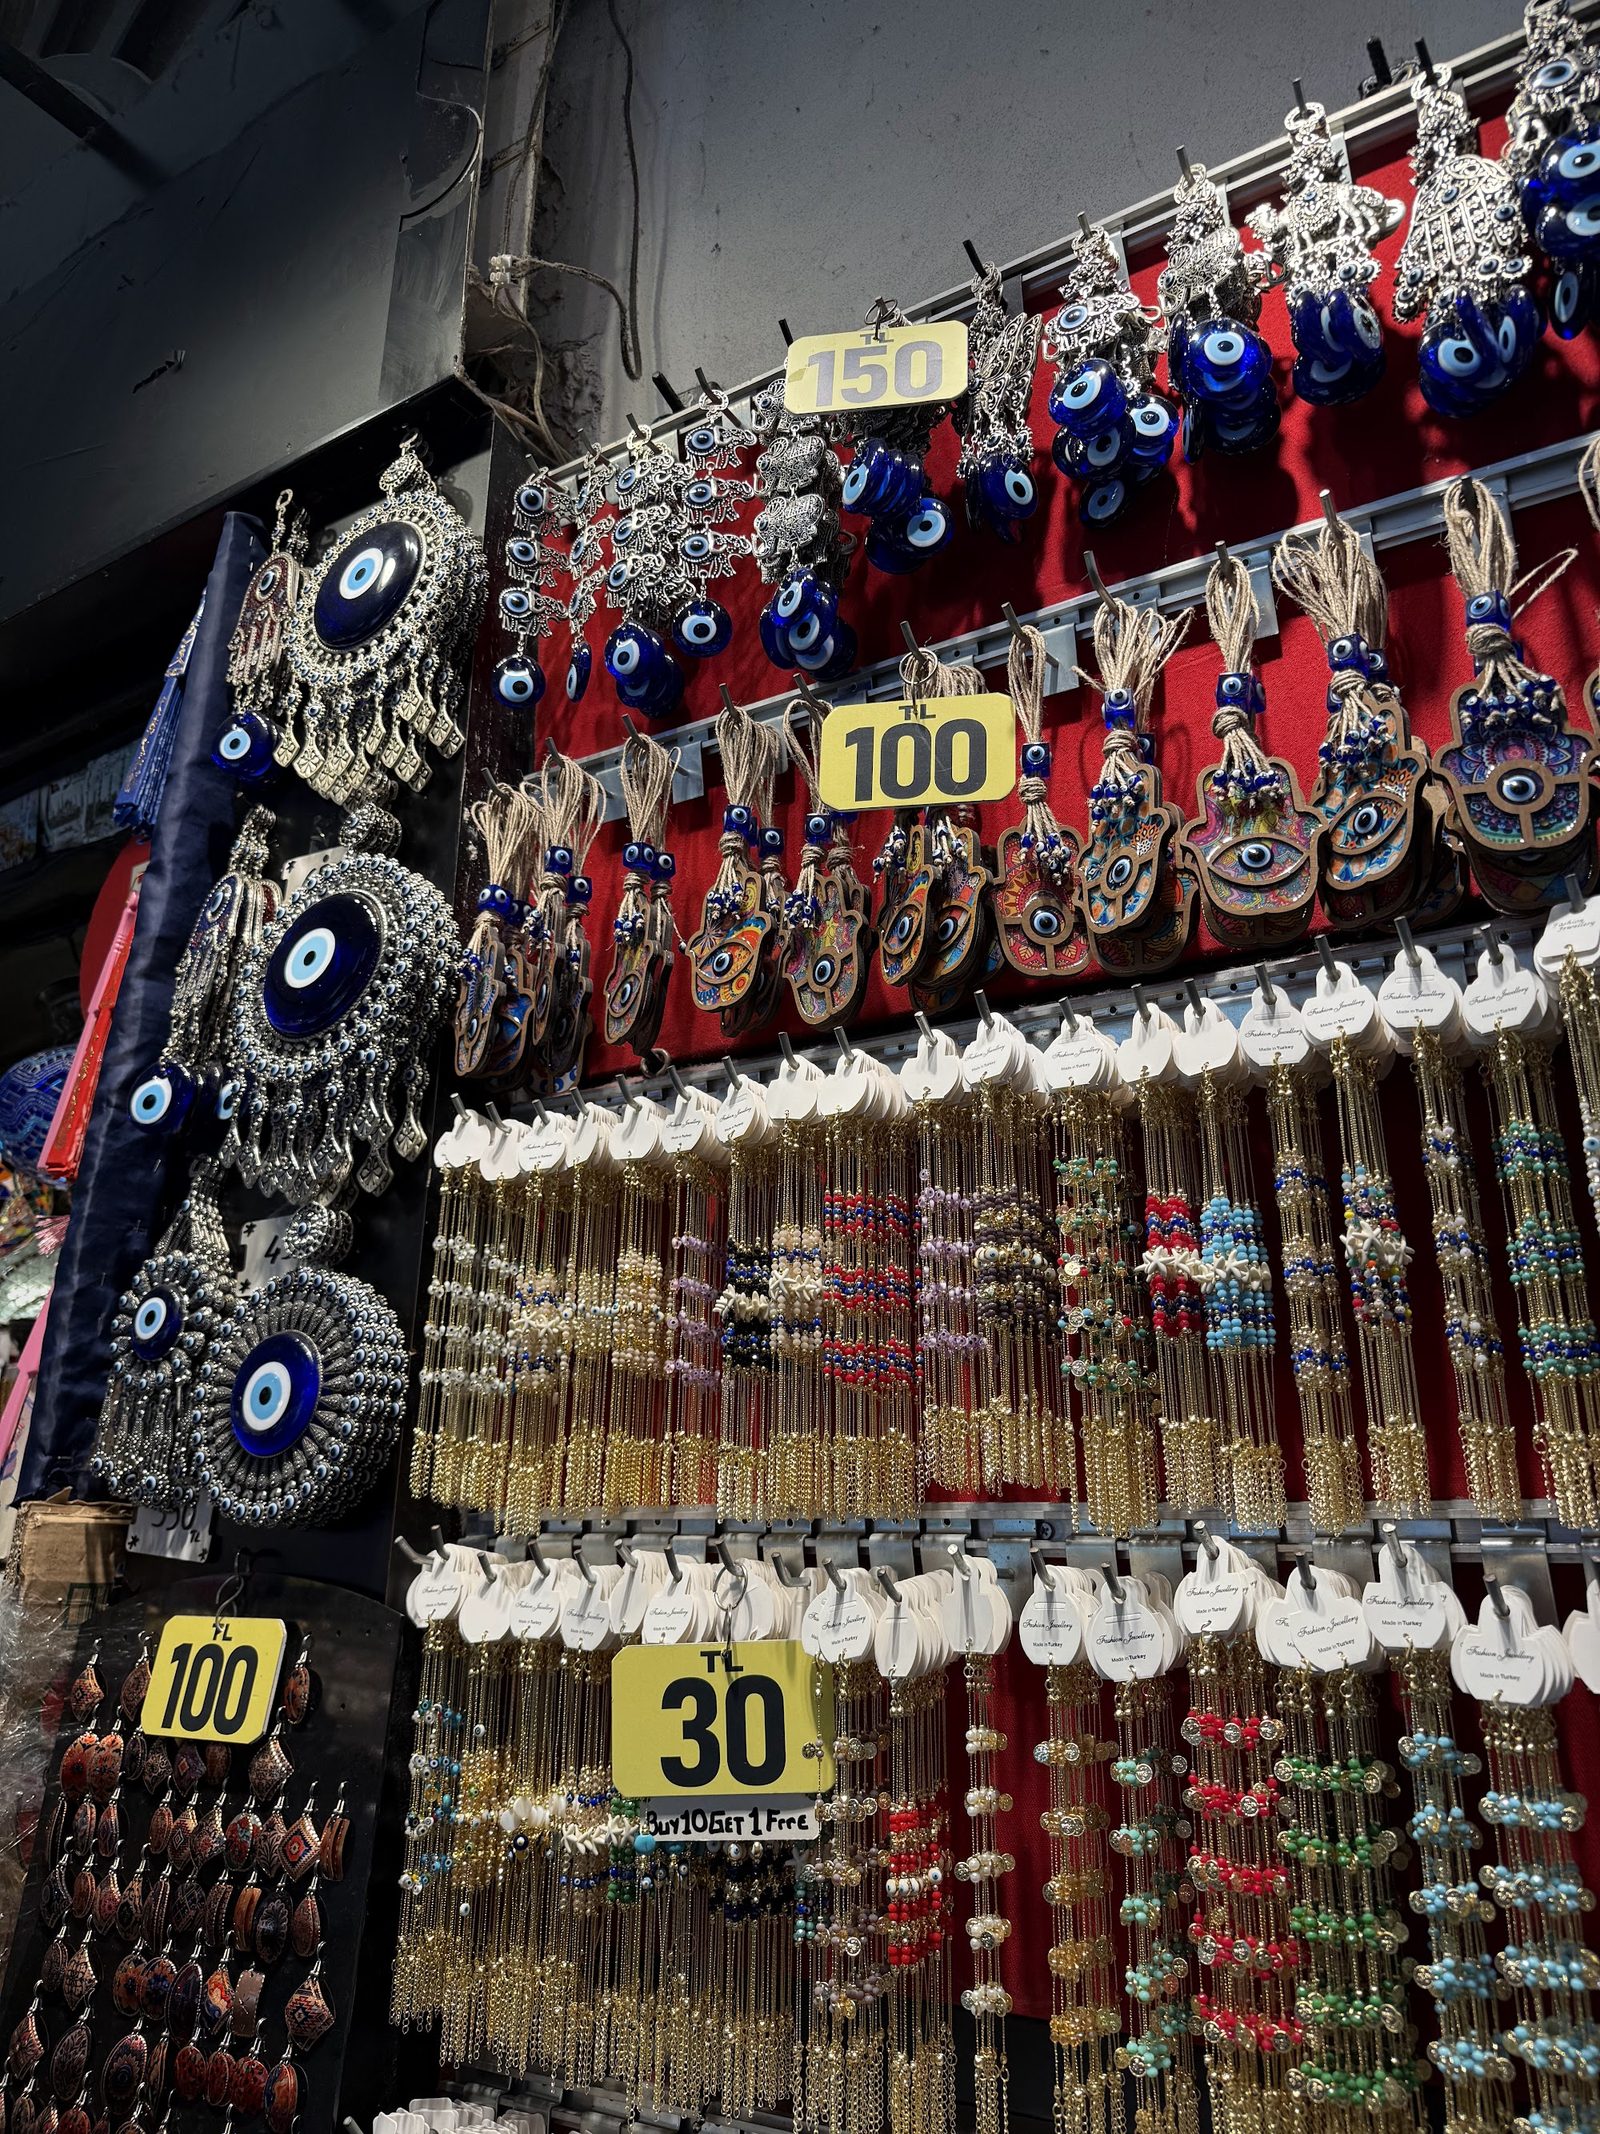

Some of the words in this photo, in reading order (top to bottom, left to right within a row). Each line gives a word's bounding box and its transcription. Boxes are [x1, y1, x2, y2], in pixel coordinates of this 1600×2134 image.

[808, 340, 943, 407] 150
[899, 704, 936, 720] TL
[845, 718, 987, 802] 100
[1366, 1595, 1397, 1605] Fashion
[1397, 1596, 1434, 1609] Jewellery
[212, 1623, 233, 1641] TL
[1096, 1634, 1123, 1644] Fashion
[1297, 1626, 1325, 1638] Fashion
[700, 1650, 744, 1673] TL
[161, 1643, 258, 1735] 100
[660, 1674, 786, 1788] 30
[748, 1807, 763, 1836] 1
